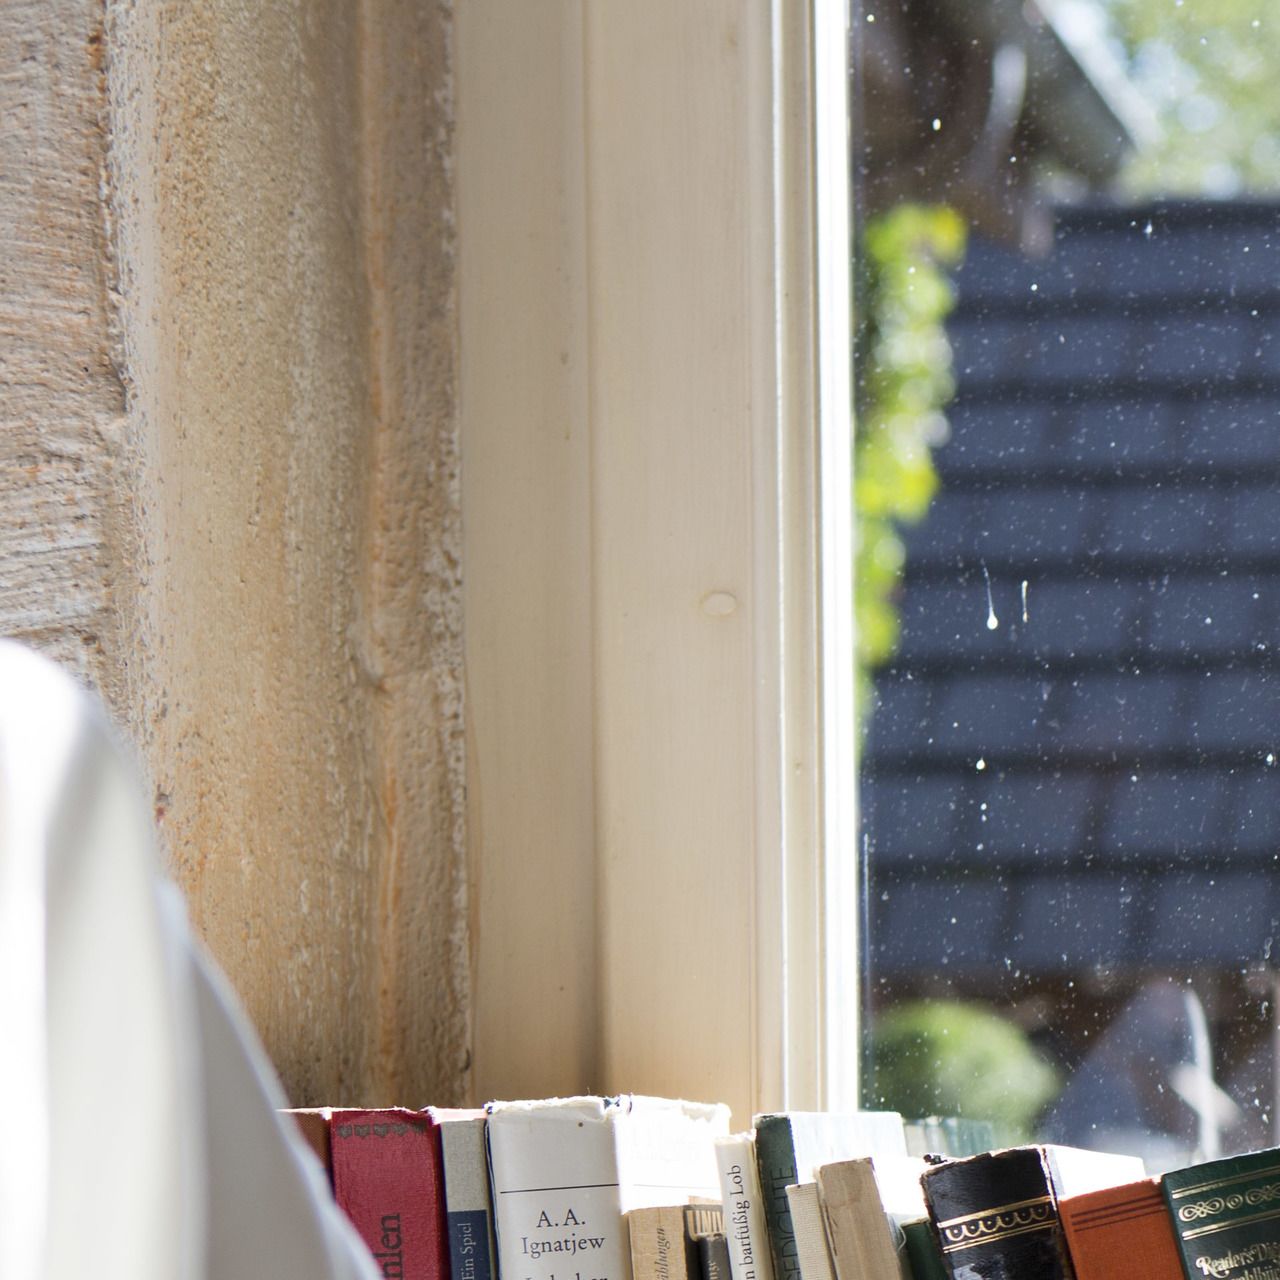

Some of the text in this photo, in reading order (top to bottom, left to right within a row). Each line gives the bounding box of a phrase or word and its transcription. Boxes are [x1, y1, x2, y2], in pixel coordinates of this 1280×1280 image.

[727, 1165, 744, 1195] Lob
[460, 1222, 475, 1254] Spiel
[521, 1236, 605, 1259] Ignatjew
[733, 1200, 755, 1266] barfüßig
